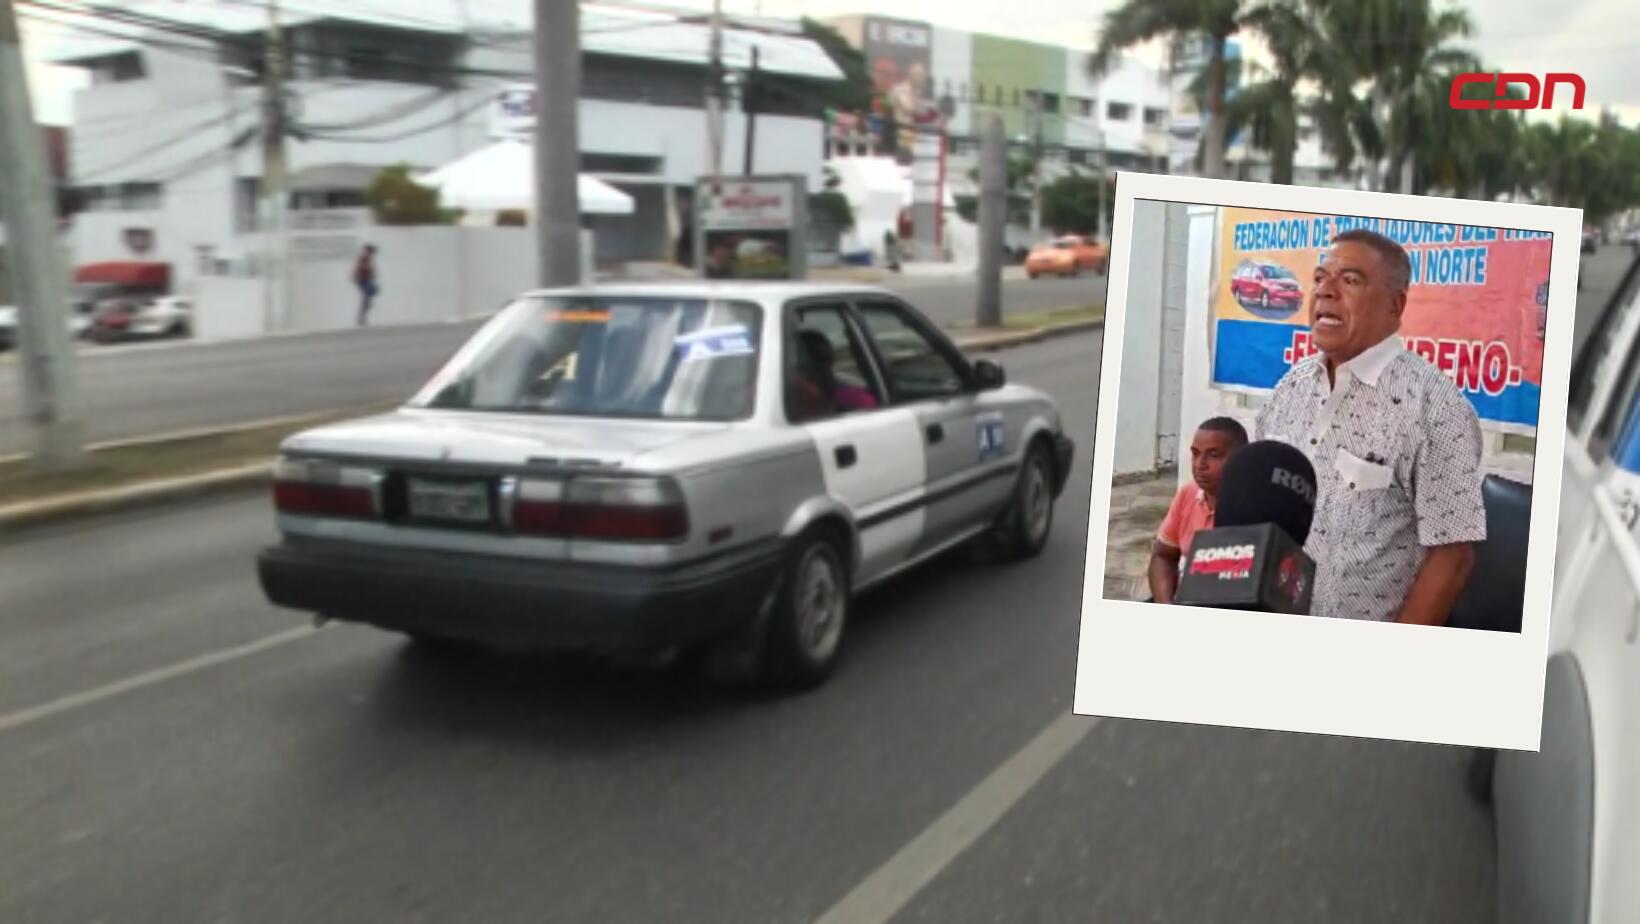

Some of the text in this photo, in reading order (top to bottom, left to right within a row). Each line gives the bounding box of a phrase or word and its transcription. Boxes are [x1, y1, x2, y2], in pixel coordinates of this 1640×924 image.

[1234, 218, 1309, 250] FEDERACION
[1312, 216, 1331, 248] DE
[1426, 247, 1487, 284] NORTE
[539, 352, 579, 381] A
[1194, 544, 1255, 562] SOMOS
